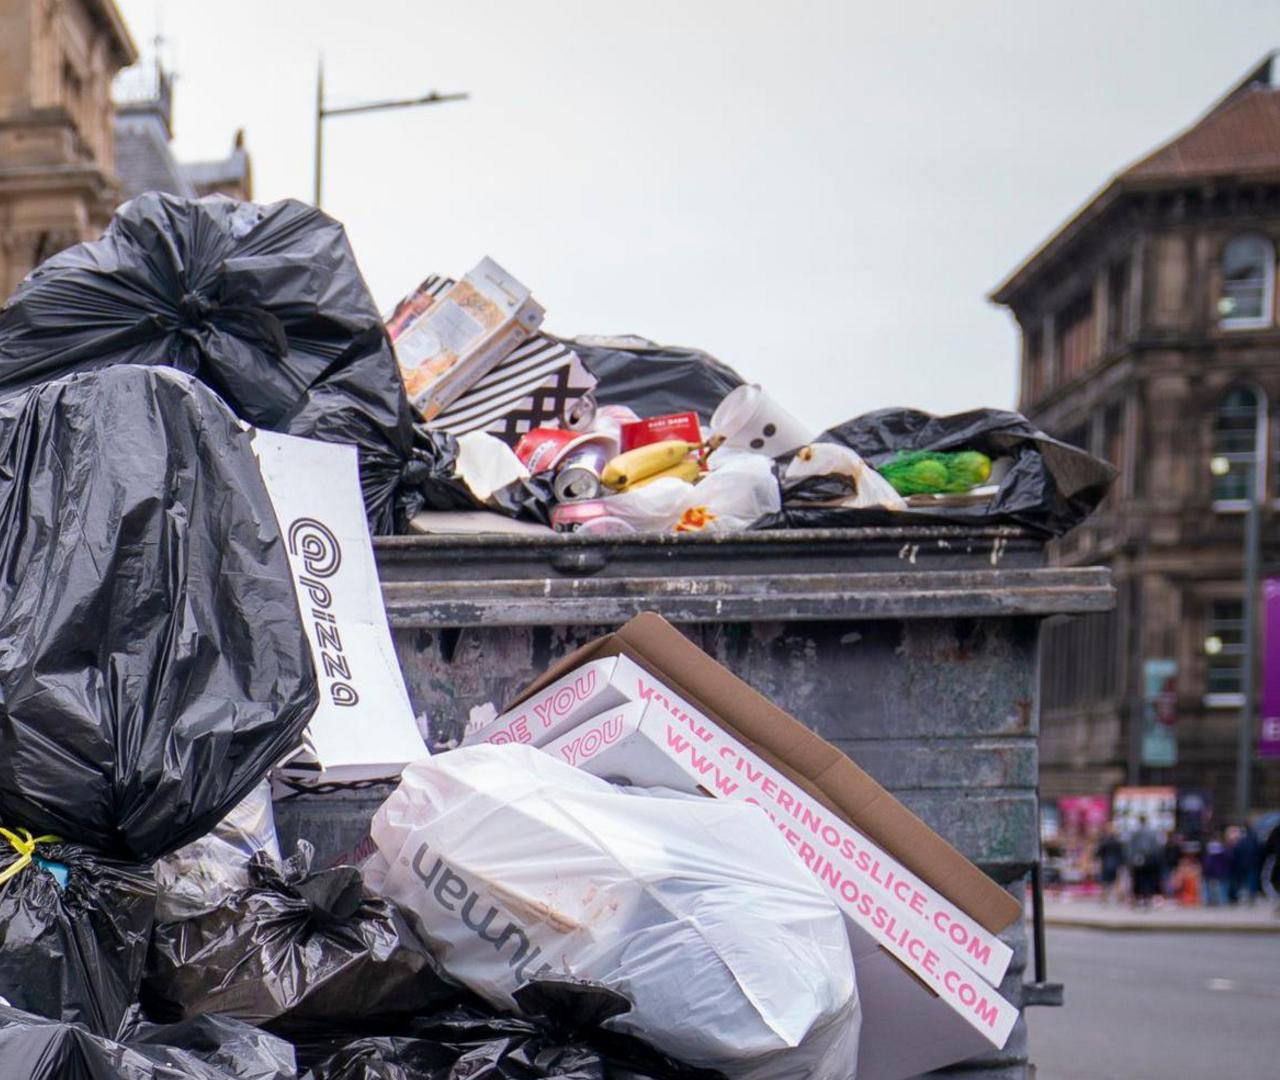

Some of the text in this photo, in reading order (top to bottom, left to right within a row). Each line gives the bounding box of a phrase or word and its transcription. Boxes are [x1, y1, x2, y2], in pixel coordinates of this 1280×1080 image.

[288, 517, 360, 707] @pizza
[533, 671, 596, 728] YOU
[561, 715, 624, 767] YOU
